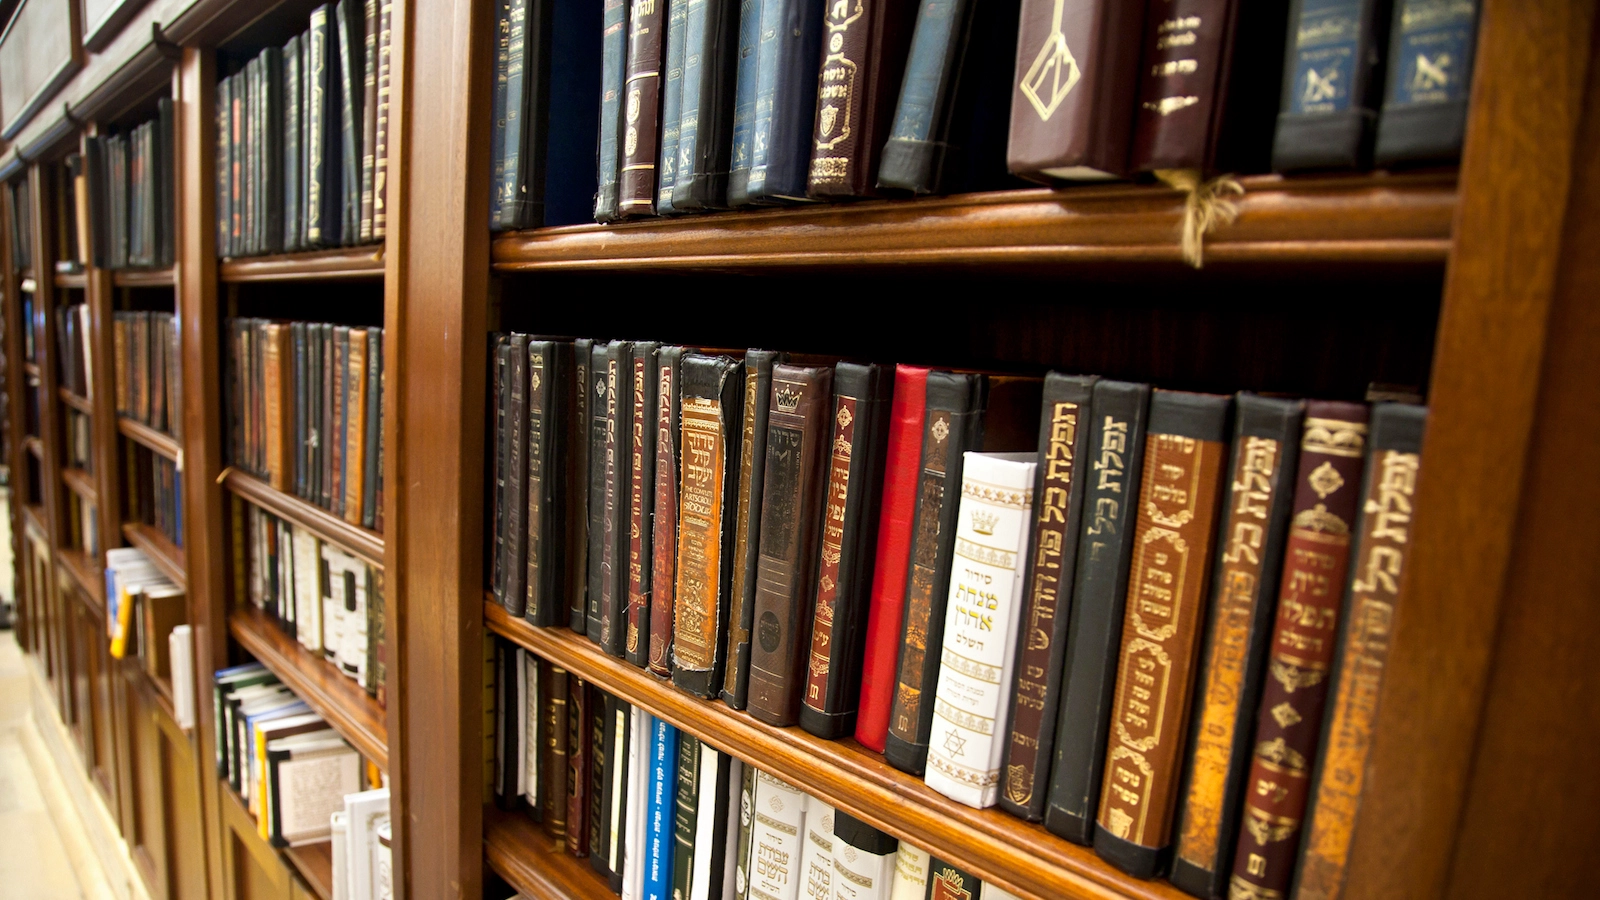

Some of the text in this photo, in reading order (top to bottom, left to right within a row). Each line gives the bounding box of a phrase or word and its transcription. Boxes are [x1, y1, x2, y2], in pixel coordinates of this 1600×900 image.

[823, 67, 846, 82] נוסח
[687, 431, 715, 451] סדור
[688, 440, 711, 467] קול
[1046, 402, 1078, 483] תפלת
[684, 492, 713, 506] ARTSCROLL
[1038, 486, 1068, 524] כל
[1087, 497, 1119, 536] כל
[1037, 528, 1063, 569] פה
[1222, 521, 1263, 565] כל
[965, 568, 992, 585] סידור
[1352, 545, 1403, 594] כל
[955, 582, 999, 612] מנחת
[1026, 572, 1058, 651] החדש
[954, 604, 994, 633] אהרן
[955, 629, 985, 652] השלם
[757, 841, 789, 865] עבודת
[766, 832, 783, 845] סידור
[756, 856, 788, 885] השם
[808, 860, 831, 886] בודת
